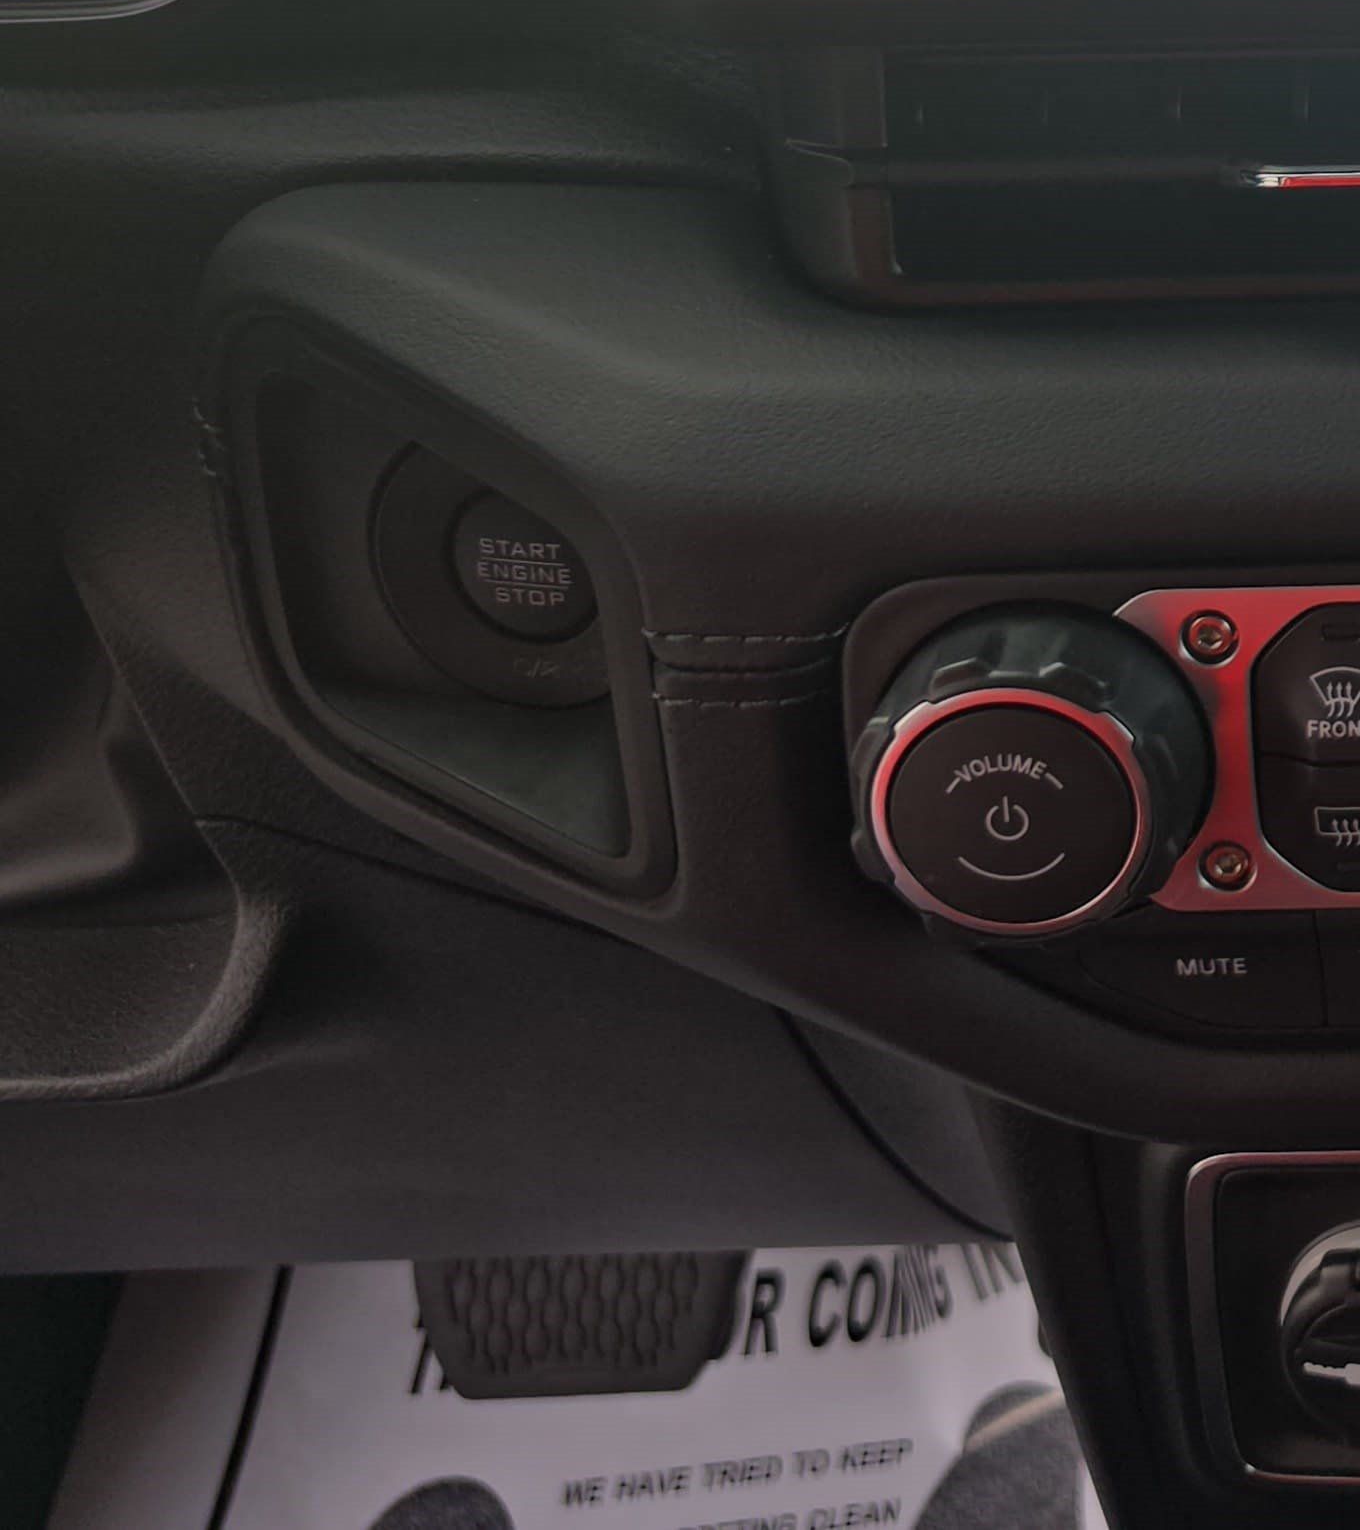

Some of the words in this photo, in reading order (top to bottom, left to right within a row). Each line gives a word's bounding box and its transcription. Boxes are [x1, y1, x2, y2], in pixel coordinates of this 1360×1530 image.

[479, 537, 561, 561] START
[476, 561, 572, 585] ENGINE
[495, 587, 566, 607] STOP
[954, 753, 1048, 784] VOLUME
[1175, 957, 1248, 976] MUTE
[562, 1476, 608, 1508] WE
[615, 1465, 692, 1503] HAVE
[702, 1454, 784, 1491] TRIED
[792, 1447, 832, 1478] TO
[839, 1437, 915, 1474] KEEP
